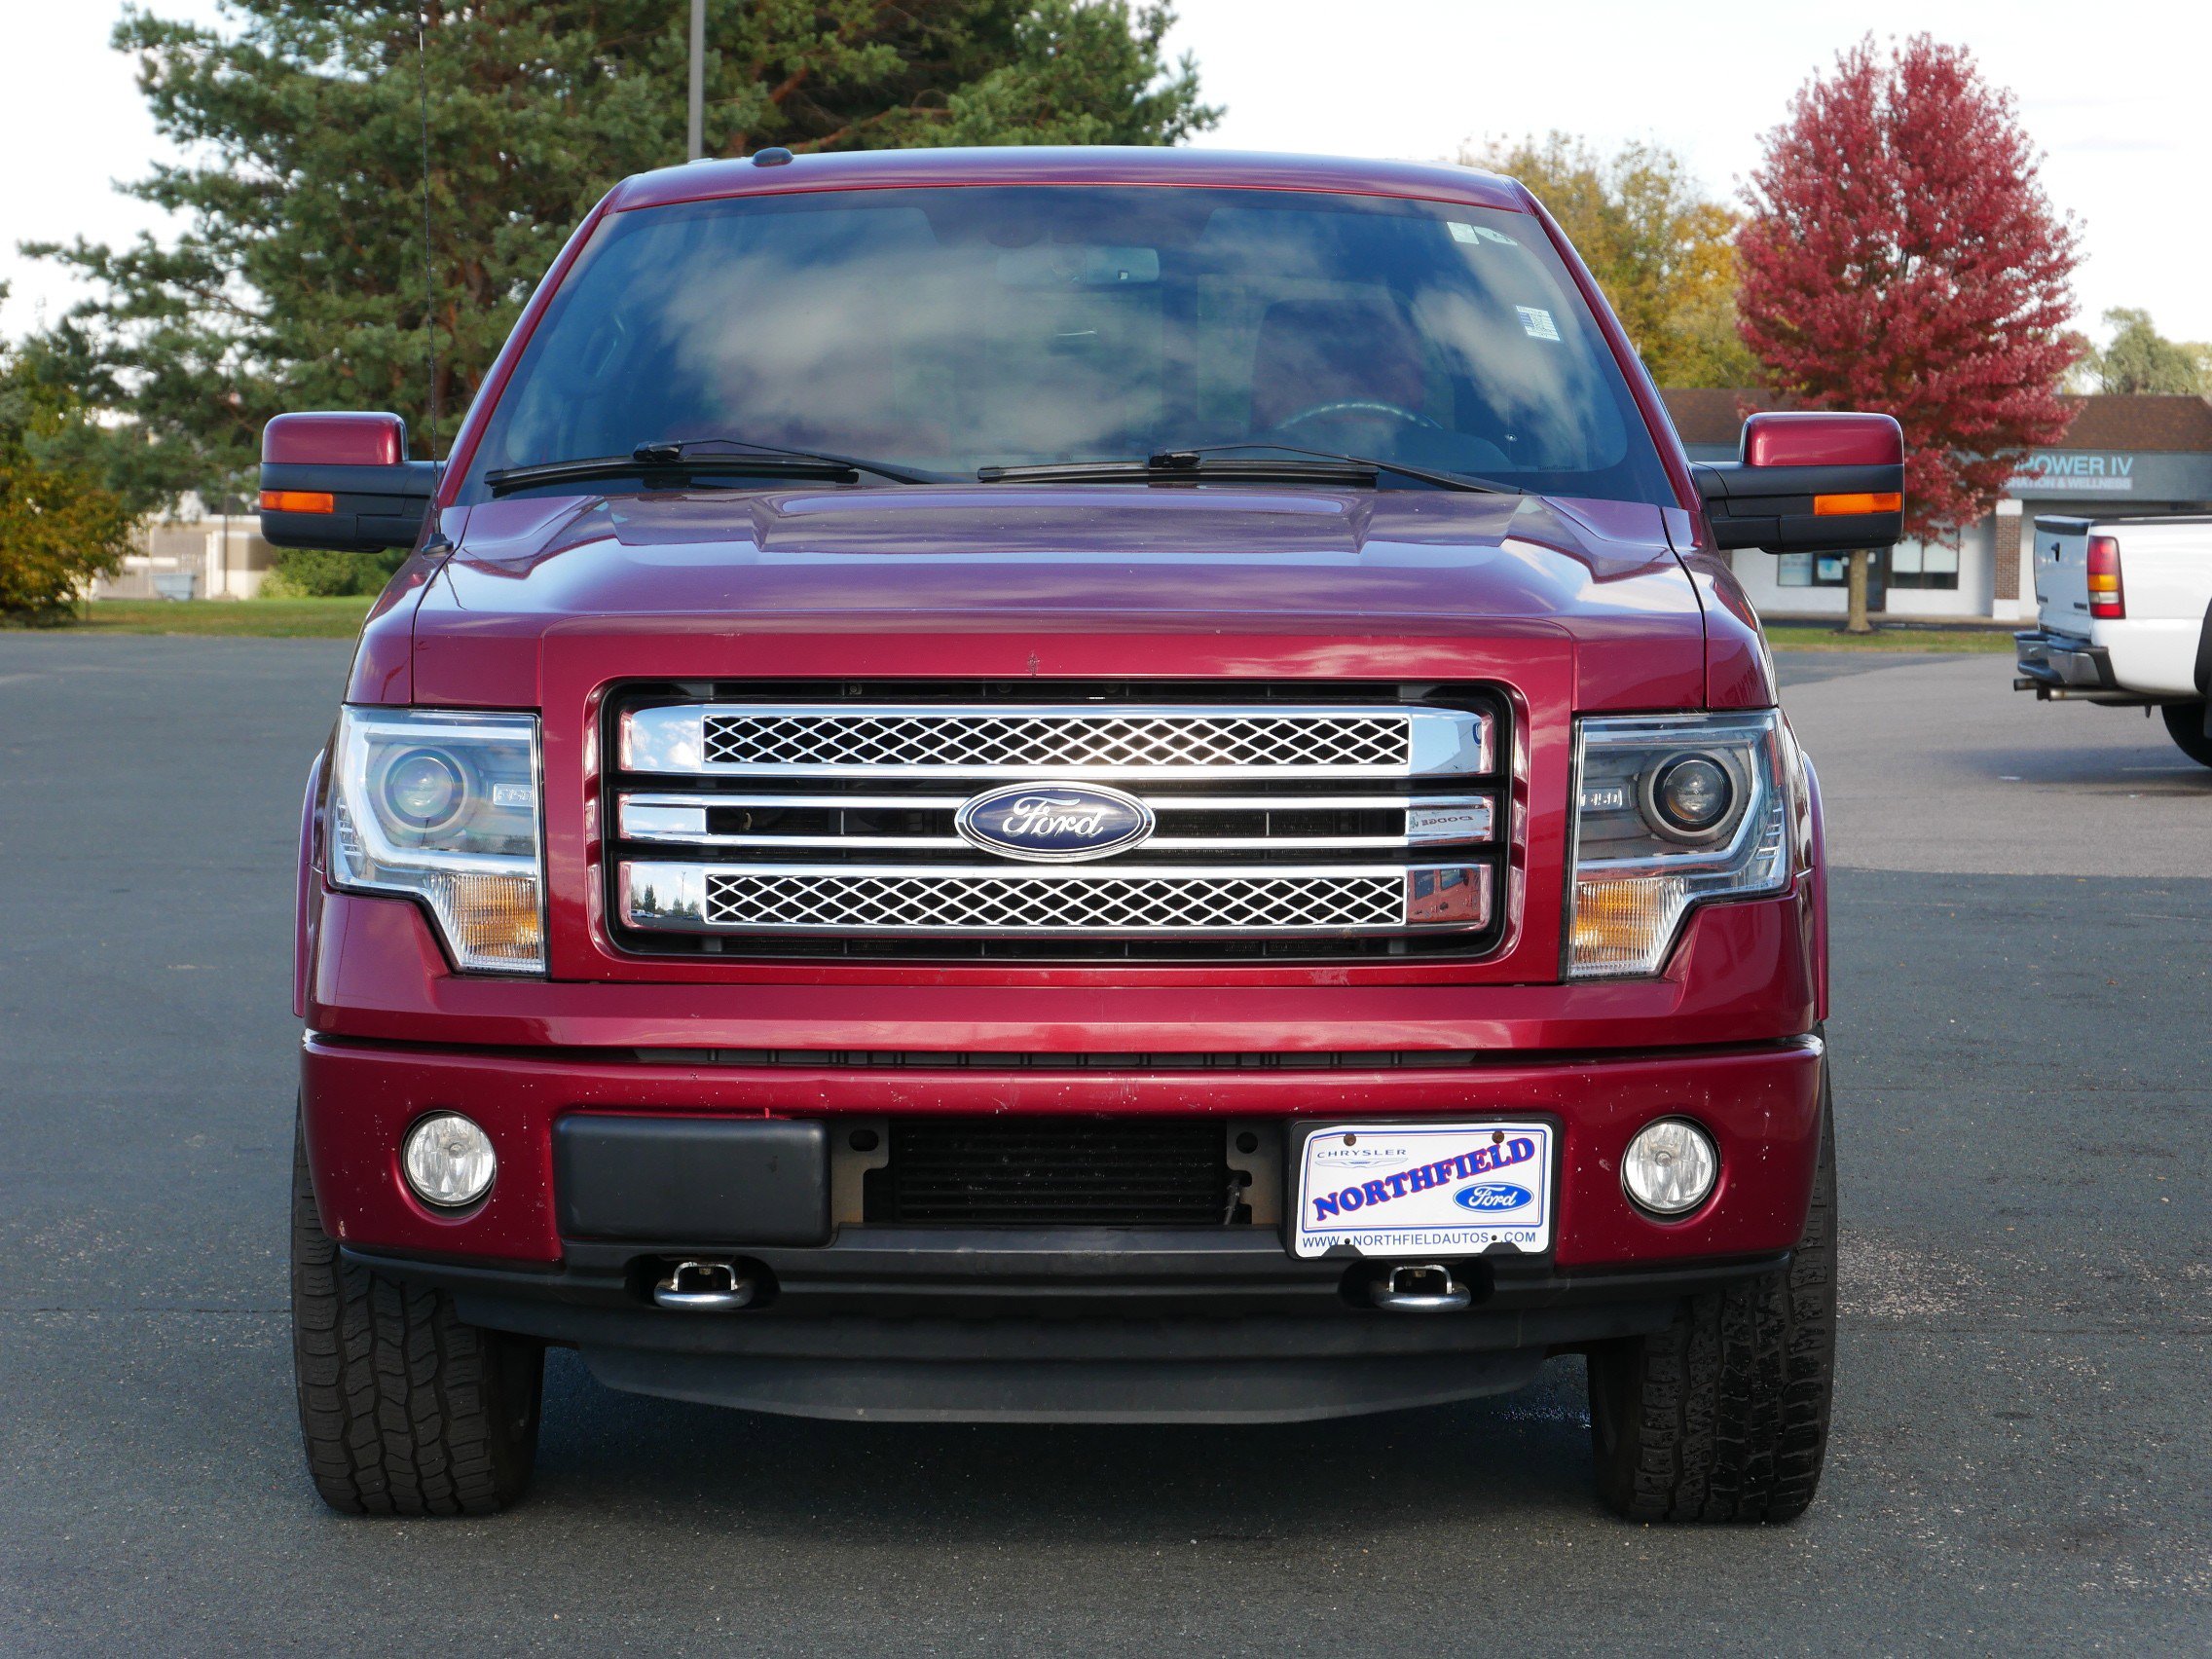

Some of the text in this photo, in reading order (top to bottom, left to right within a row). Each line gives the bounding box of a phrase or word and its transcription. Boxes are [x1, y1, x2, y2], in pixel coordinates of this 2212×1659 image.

[2111, 456, 2134, 477] IV
[1002, 795, 1107, 838] Ford
[1316, 1149, 1407, 1159] CHRYSLER
[1312, 1137, 1536, 1222] NORTHFIELD
[1468, 1185, 1518, 1208] Ford
